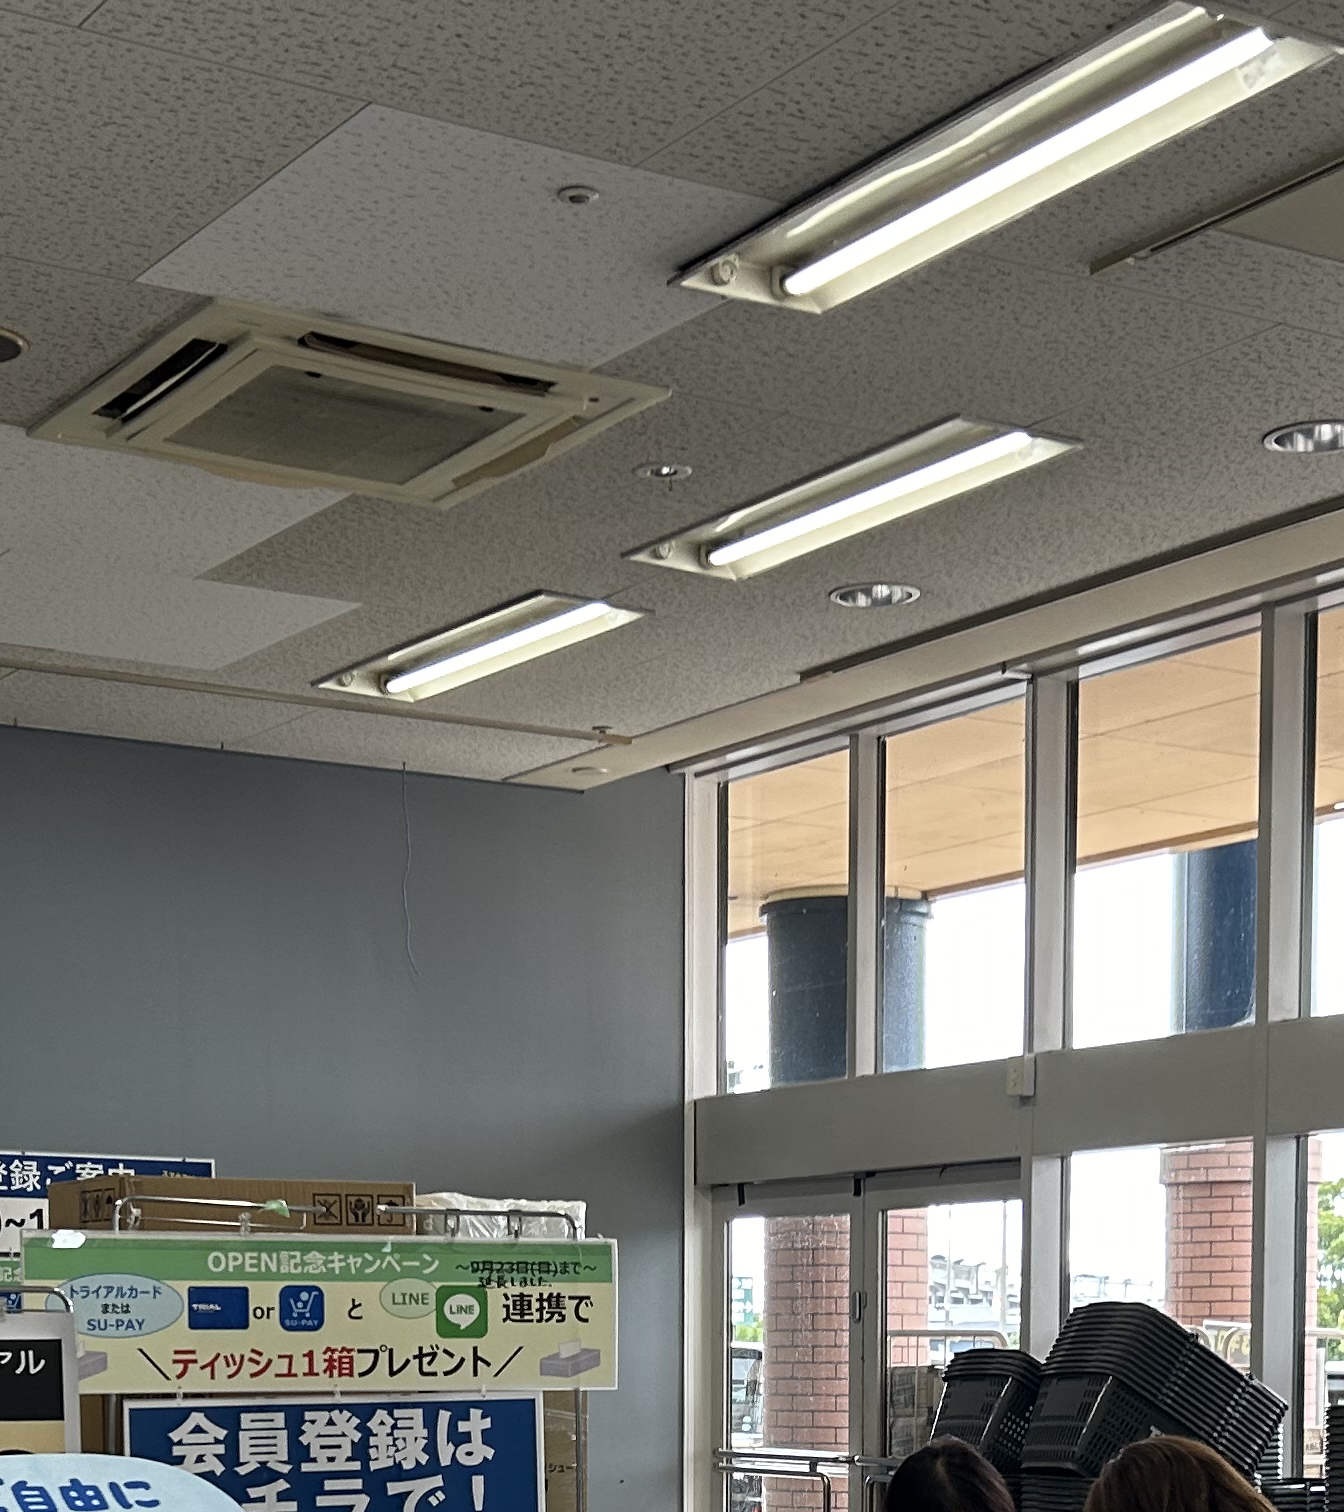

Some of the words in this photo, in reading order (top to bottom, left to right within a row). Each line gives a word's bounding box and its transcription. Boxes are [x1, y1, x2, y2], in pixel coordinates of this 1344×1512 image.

[207, 1250, 441, 1276] OPEN記念キャンペーン
[69, 1285, 162, 1300] トライアルカード
[391, 1292, 430, 1307] LINE
[101, 1303, 131, 1314] または
[252, 1305, 276, 1320] or
[347, 1298, 363, 1320] と
[449, 1304, 475, 1316] LINE
[502, 1292, 594, 1325] 連携で
[86, 1318, 146, 1332] SU-PAY
[171, 1345, 495, 1380] ティッシュ1箱プレゼント
[168, 1407, 497, 1476] 会員登録は
